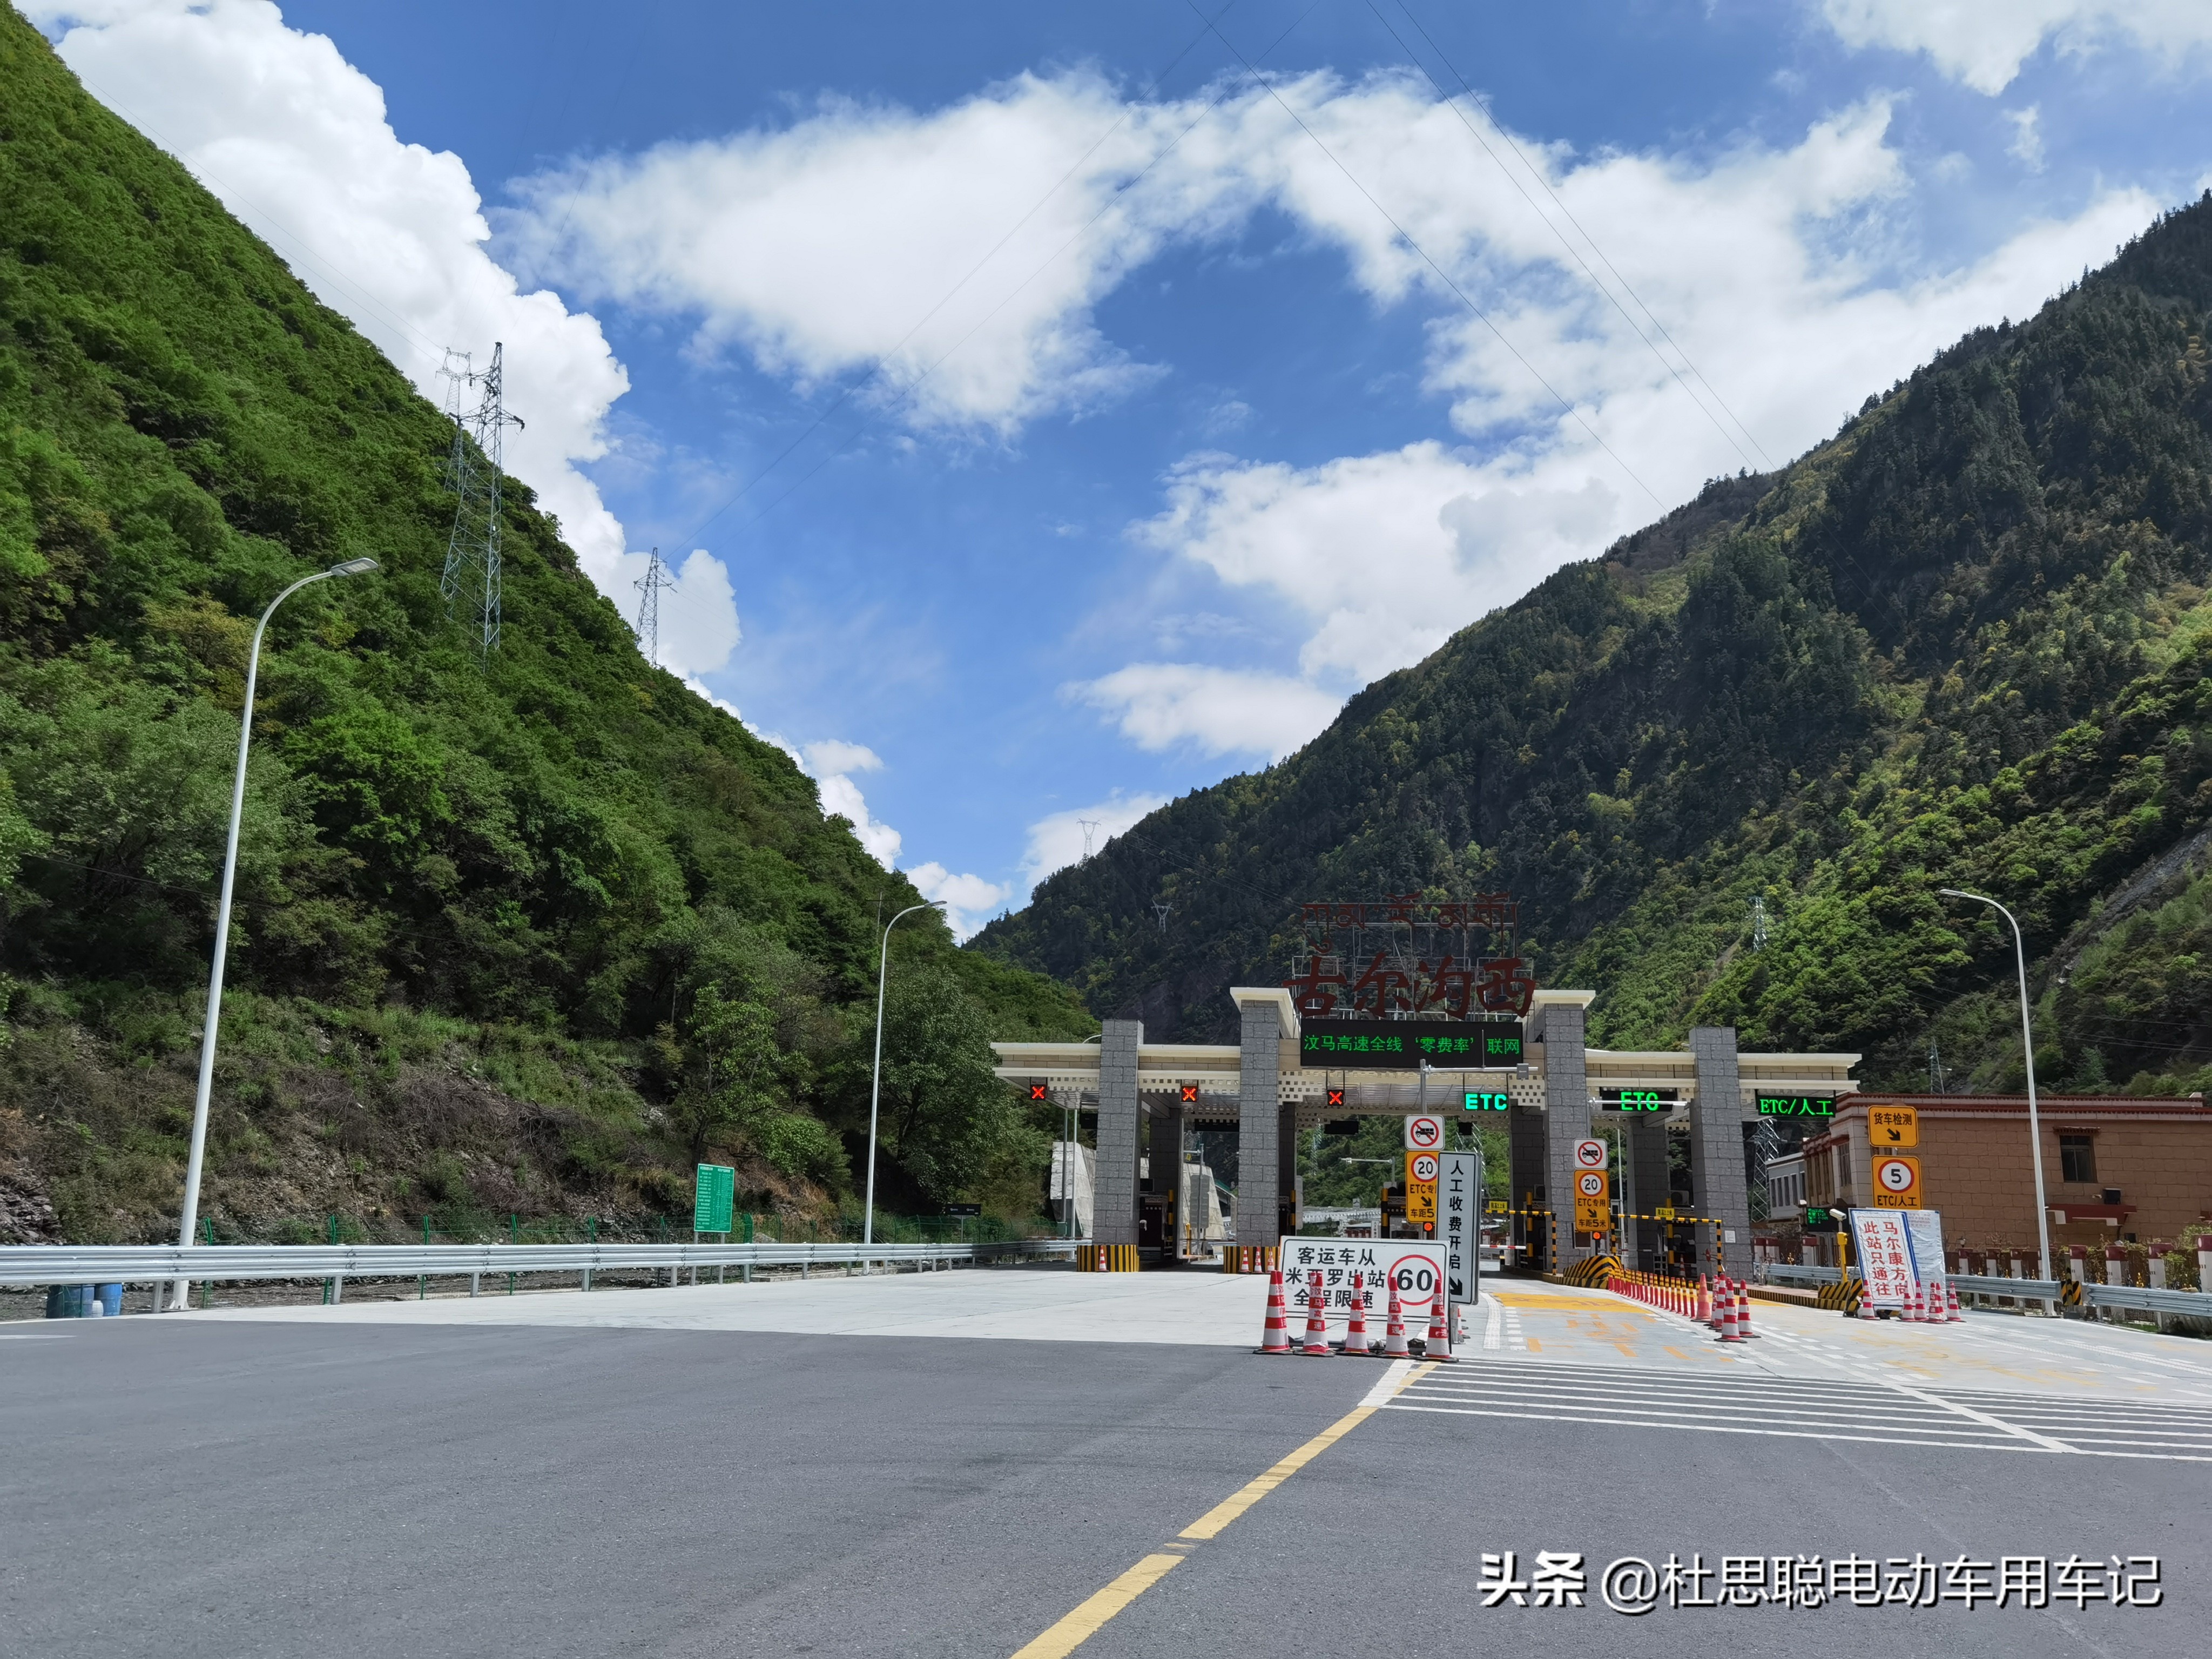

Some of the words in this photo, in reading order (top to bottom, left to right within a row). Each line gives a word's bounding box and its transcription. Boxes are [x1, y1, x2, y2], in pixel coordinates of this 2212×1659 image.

[1283, 952, 1536, 1020] 古尔沟西
[1465, 1094, 1507, 1110] ETC
[1621, 1091, 1658, 1111] ETC
[1760, 1098, 1833, 1116] ETC/人工
[1874, 1112, 1912, 1125] 货车检测
[1418, 1161, 1433, 1175] 20
[1891, 1169, 1901, 1183] 5
[1410, 1184, 1437, 1193] ETC专
[1584, 1179, 1598, 1190] 20
[1577, 1198, 1606, 1207] ETC专用
[1877, 1195, 1917, 1207] ETC/人工
[1448, 1160, 1464, 1270] 人工收费开启
[1579, 1219, 1607, 1228] 车距5米
[1297, 1246, 1376, 1266] 客运车从
[1864, 1220, 1892, 1297] 此站只通往
[1883, 1221, 1908, 1297] 马尔康方向
[1397, 1269, 1432, 1291] 60
[1390, 1291, 1400, 1334] 汶马高速
